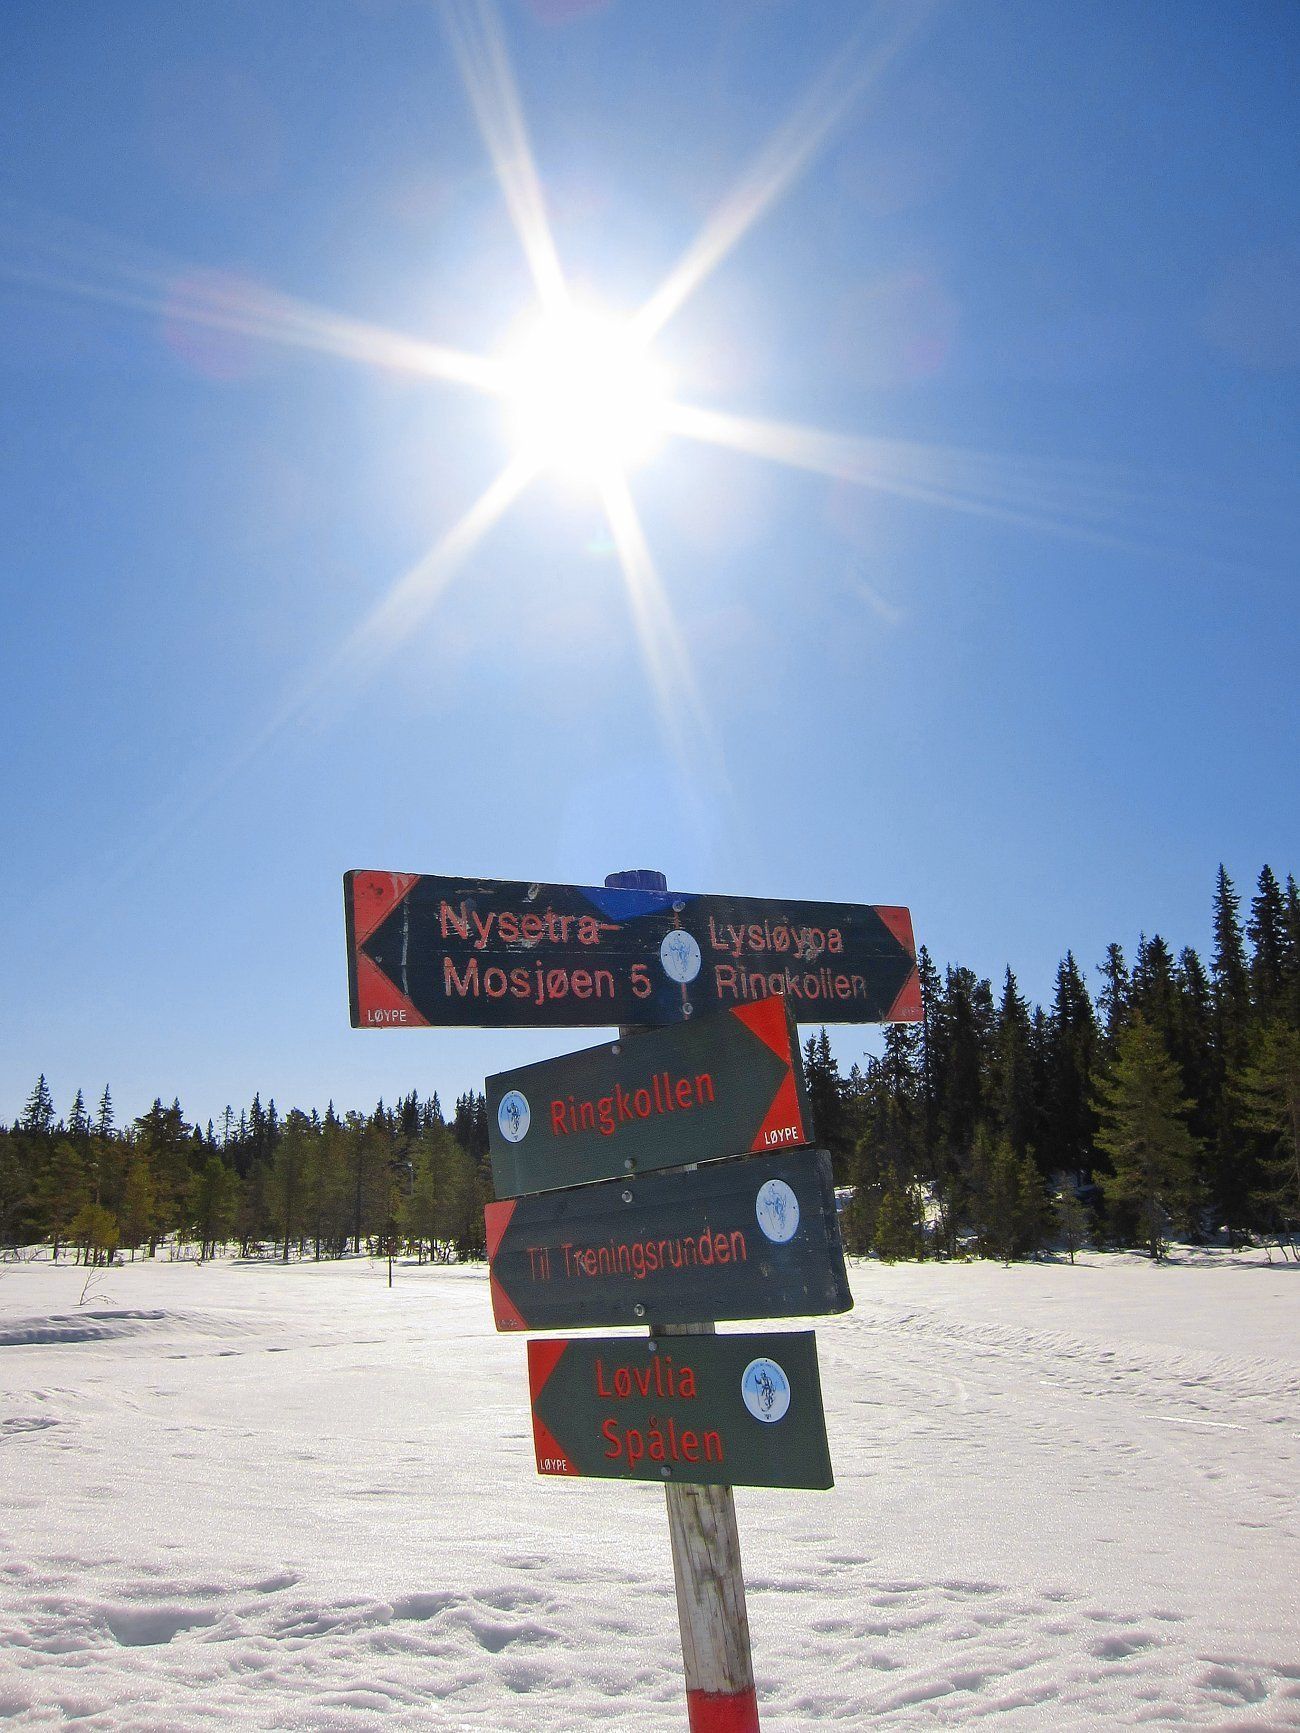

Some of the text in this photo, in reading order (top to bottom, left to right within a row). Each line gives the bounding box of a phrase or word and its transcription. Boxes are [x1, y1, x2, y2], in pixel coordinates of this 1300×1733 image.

[443, 956, 652, 1006] Mosjøen 5
[367, 1008, 407, 1023] LØYPE
[550, 1071, 716, 1136] Ringkollen
[764, 1125, 799, 1145] LØYPE
[527, 1226, 747, 1280] Til Treningsrunden
[595, 1356, 696, 1398] Løvlia
[539, 1458, 568, 1472] LØYPE
[602, 1415, 724, 1471] Spålen
